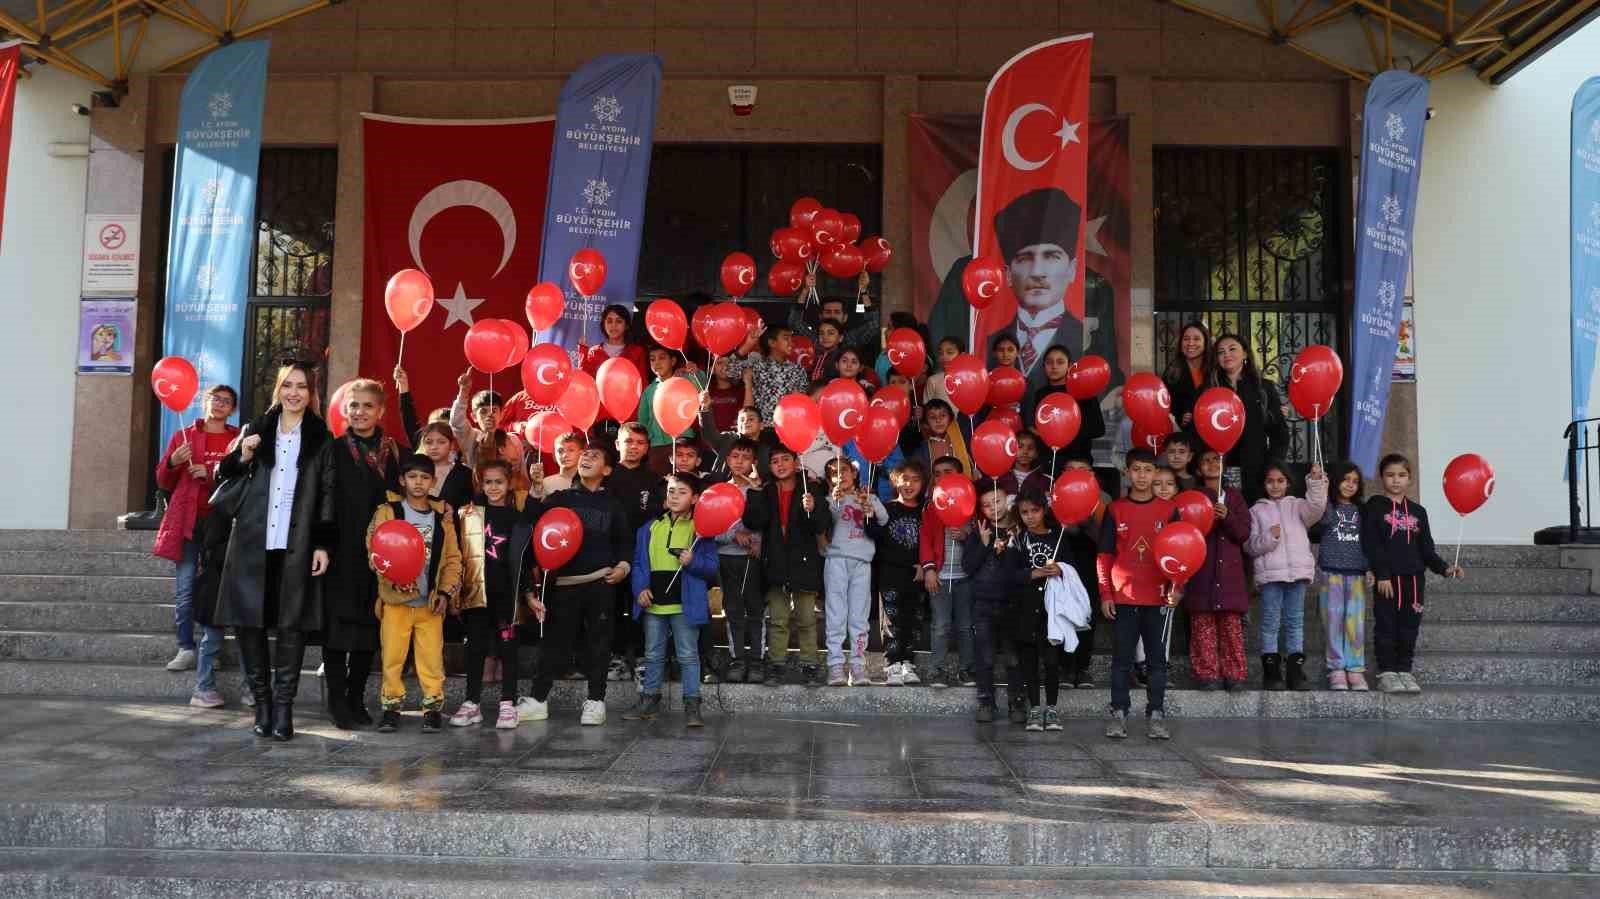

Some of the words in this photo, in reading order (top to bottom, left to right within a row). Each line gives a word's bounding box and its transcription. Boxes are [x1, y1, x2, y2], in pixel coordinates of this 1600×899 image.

[584, 122, 597, 131] T.C.
[601, 125, 626, 134] AYDIN
[565, 129, 641, 146] BÜYÜKŞEHİR
[578, 142, 627, 153] BELEDİYESİ
[1369, 142, 1417, 169] BÜYÜKŞEHİR
[575, 207, 588, 217] T.C.
[591, 208, 617, 218] AYDIN
[556, 213, 631, 230] BÜYÜKŞEHİR
[568, 226, 617, 238] BELEDİYESİ
